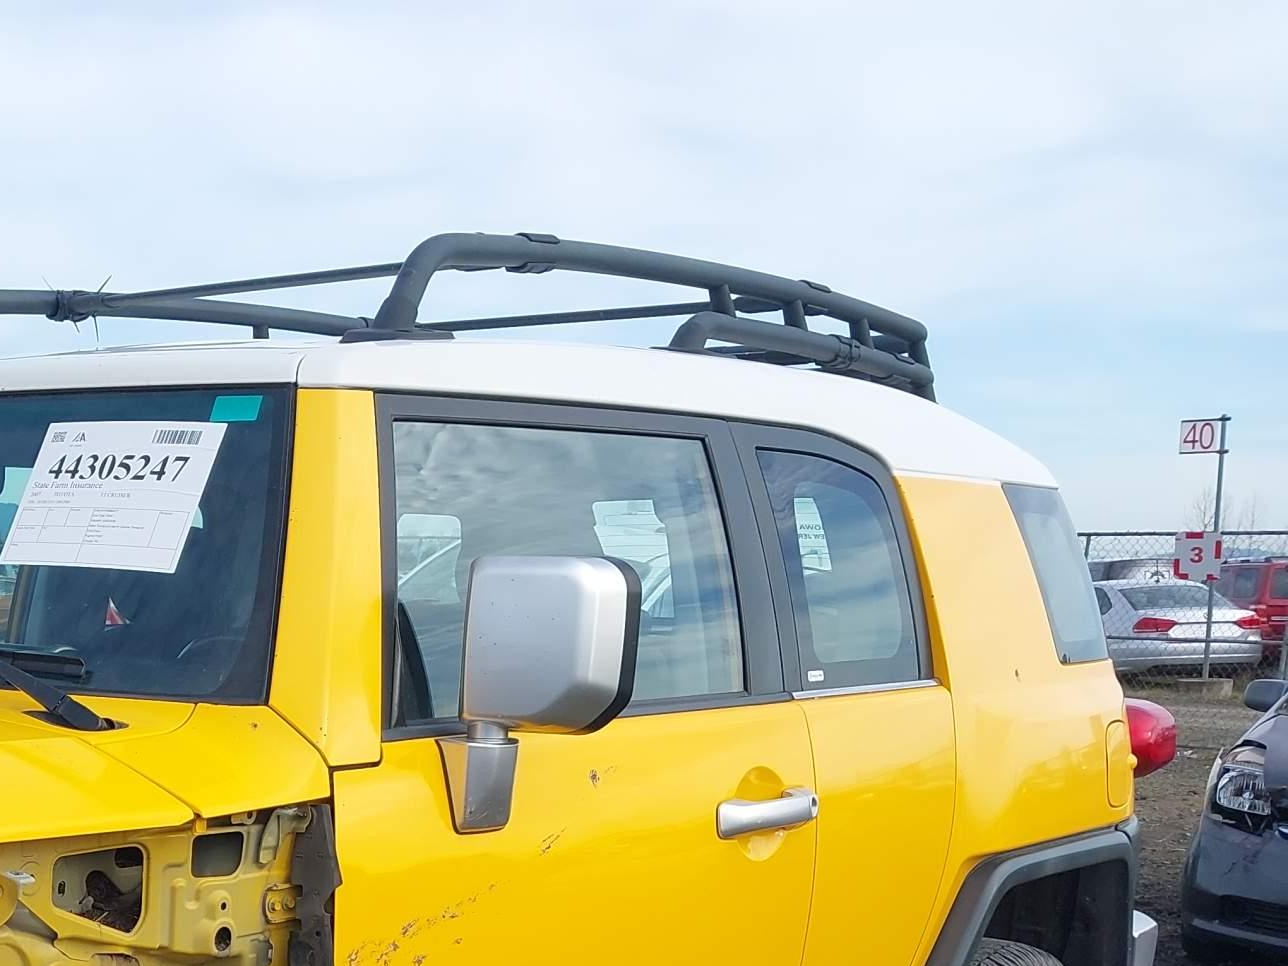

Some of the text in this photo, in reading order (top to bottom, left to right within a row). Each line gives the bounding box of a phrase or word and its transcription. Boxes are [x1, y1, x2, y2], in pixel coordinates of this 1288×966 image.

[1183, 422, 1215, 450] 40
[48, 454, 191, 482] 44305247
[32, 481, 104, 490] State Farm Insurance
[1189, 546, 1204, 563] 3
